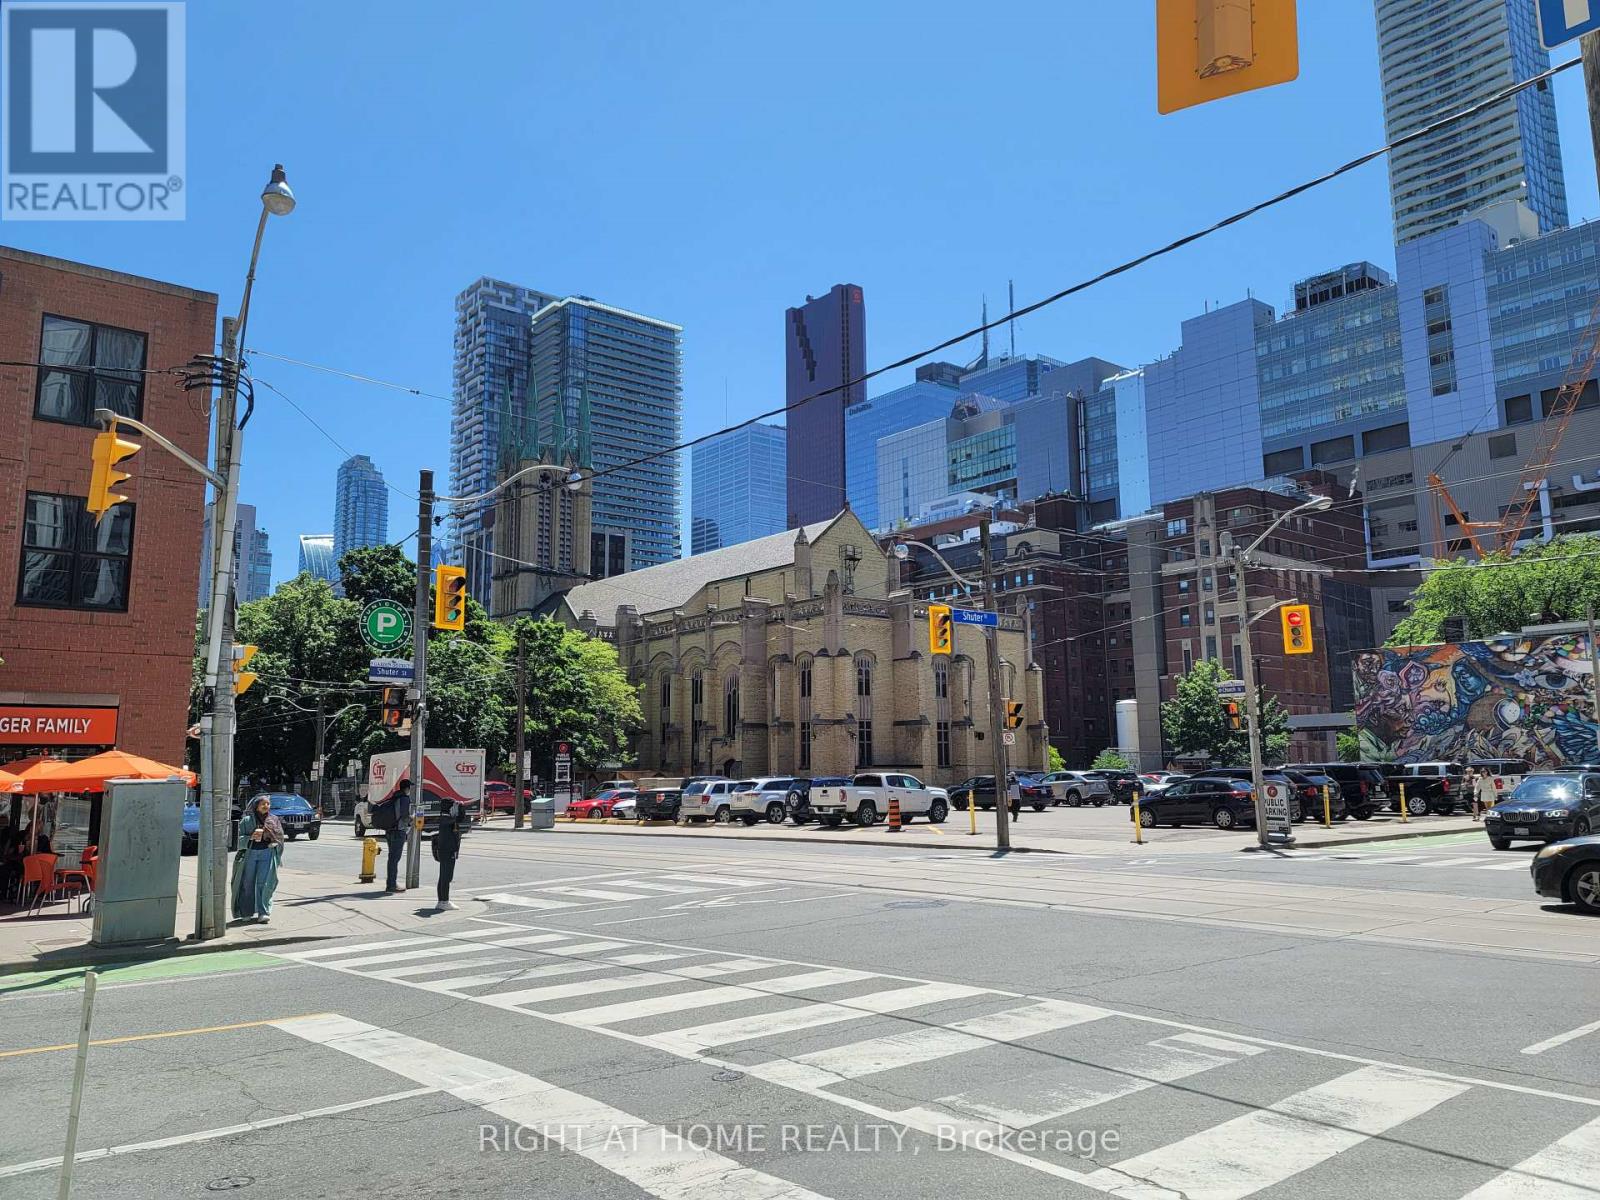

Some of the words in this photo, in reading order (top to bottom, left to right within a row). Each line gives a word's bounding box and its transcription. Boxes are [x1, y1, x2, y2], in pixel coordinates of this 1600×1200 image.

[361, 602, 409, 624] MUNICIPAL
[962, 610, 984, 623] Shuter
[377, 612, 397, 633] P
[361, 628, 409, 650] PARKING
[376, 667, 399, 676] Shuter
[0, 717, 31, 733] GER
[36, 718, 91, 734] FAMILY
[1265, 808, 1287, 816] ARKING
